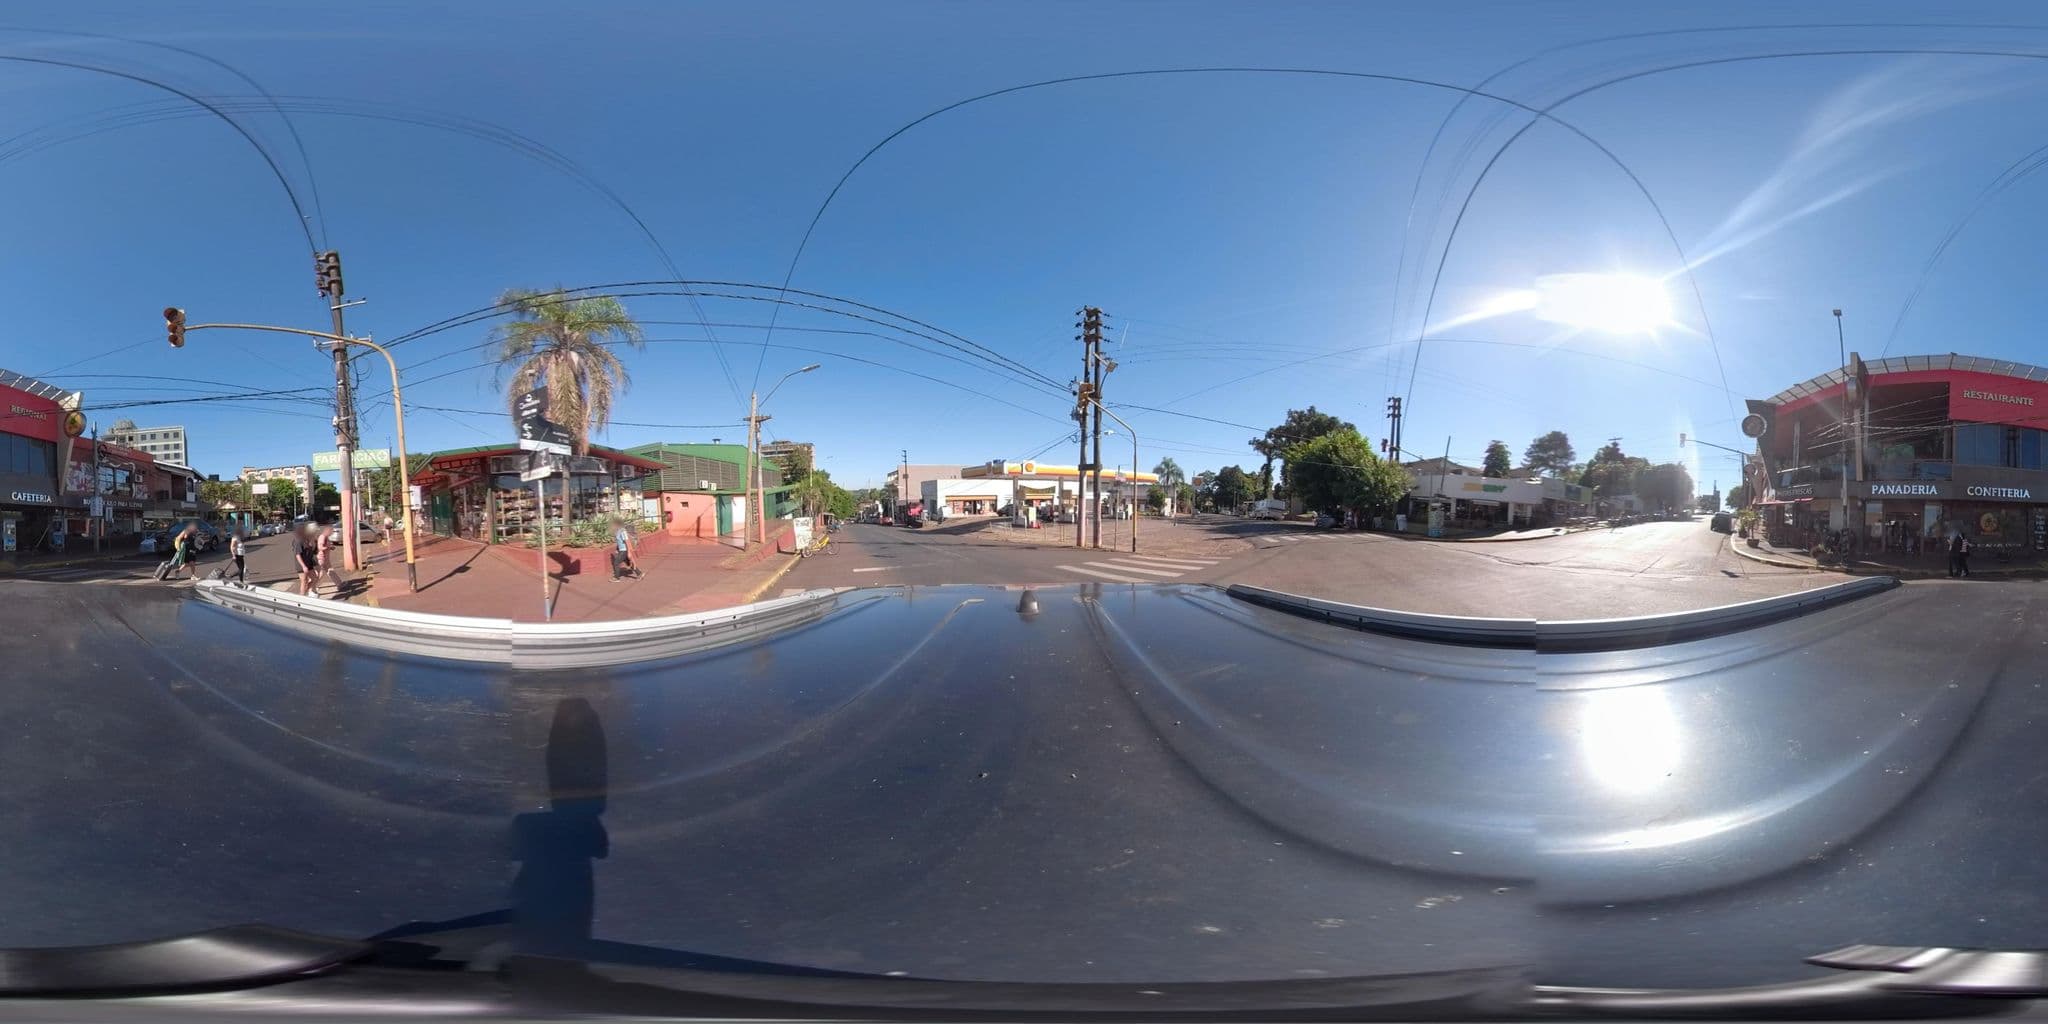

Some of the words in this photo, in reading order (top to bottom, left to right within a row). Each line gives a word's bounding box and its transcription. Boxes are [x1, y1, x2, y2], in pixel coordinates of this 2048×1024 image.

[1963, 390, 2034, 406] RESTAURANTE
[1871, 484, 1938, 495] PANADERIA
[1966, 486, 2030, 499] CONFITERIA
[11, 491, 53, 504] CAFETERIA
